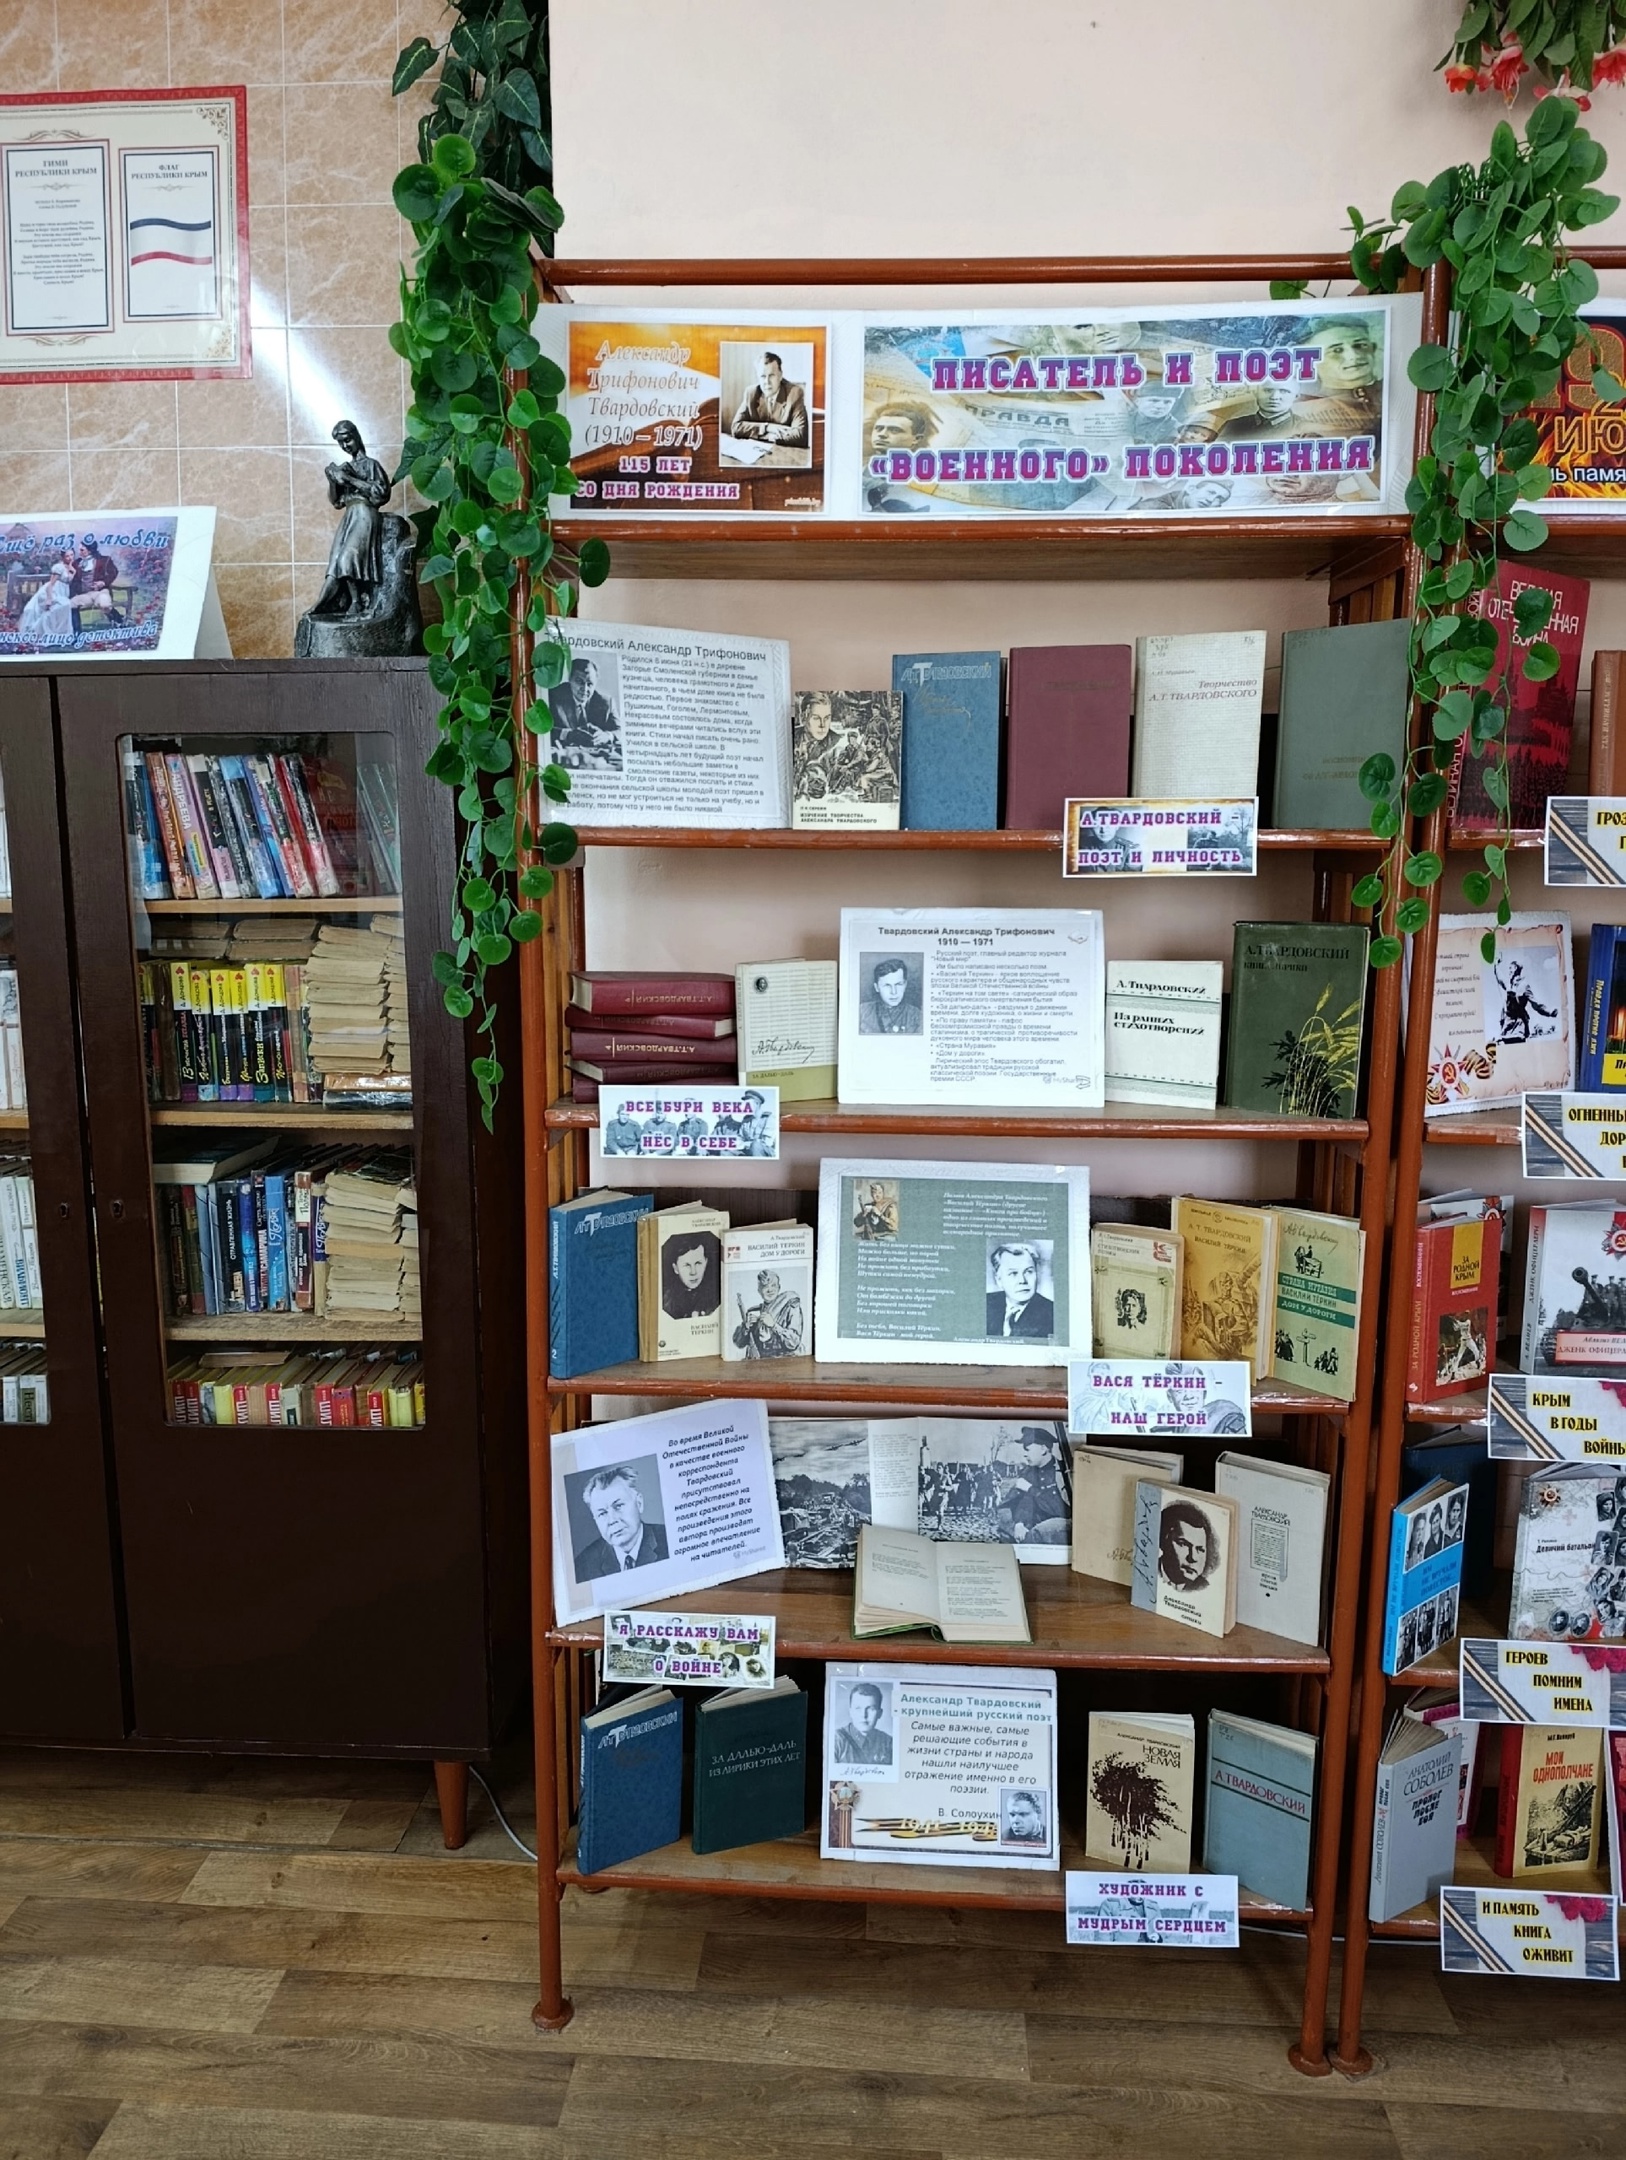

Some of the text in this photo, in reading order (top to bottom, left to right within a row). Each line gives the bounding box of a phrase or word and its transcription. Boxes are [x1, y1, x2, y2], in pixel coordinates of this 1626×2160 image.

[43, 159, 68, 167] ГИМН
[158, 163, 180, 172] ФЛАГ
[15, 167, 97, 178] РЕСПУБЛИКИ КРЫМ
[131, 171, 208, 180] РЕСПУБЛИКИ КРЫМ
[596, 341, 691, 365] Александр
[931, 344, 1324, 392] ПИСАТЕЛЬ И ПОЭТ
[588, 368, 699, 394] Трифонович
[589, 396, 700, 421] Твардовский
[619, 456, 692, 473] 115 ЛЕТ
[868, 436, 1376, 485] «ВОЕННОГО» ПОКОЛЕНИЯ
[602, 481, 640, 499] ДНЯ
[645, 482, 740, 500] РОЖДЕНИЯ
[39, 533, 75, 556] раз
[83, 532, 96, 546] о
[99, 529, 170, 549] любви
[38, 621, 158, 649] лицо детектива
[627, 640, 766, 662] Александр Трифонович
[1198, 679, 1258, 690] Творчество
[1170, 689, 1258, 700] ТВАРДОВСКОГО
[171, 773, 192, 829] АНДРЕЕВА
[1080, 808, 1222, 827] А.ТВАРДОВСКИЙ
[1078, 848, 1241, 866] ПОЭТ И ЛИЧНОСТЬ
[878, 926, 1055, 938] Твардовский Александр Трифонович
[937, 938, 994, 946] 1910 1971
[1114, 1012, 1175, 1025] Из ранних
[1114, 1021, 1205, 1036] стихотворений
[616, 1044, 695, 1053] А.Т.ТВАРДОВСКИЙ
[625, 1100, 753, 1114] ВСЕ БУРИ ВЕКА
[643, 1132, 737, 1149] НЁС В СЕБЕ
[1204, 1223, 1251, 1243] ТВАРДОВСКИЙ
[228, 1222, 237, 1260] ОТРАВЛЕННАЯ
[748, 1241, 806, 1251] ВАСИЛИЙ ТЕРКИН
[1453, 1260, 1480, 1273] РОДНОЙ
[1462, 1256, 1470, 1264] ЗА
[1455, 1271, 1475, 1281] КРЫМ
[1281, 1301, 1337, 1320] ДОМ ДОРОГИ
[1557, 1346, 1586, 1354] ДЖЕНК
[1093, 1373, 1206, 1389] ВАСЯ ТЁРКИН
[1533, 1393, 1571, 1408] КРЫМ
[1111, 1409, 1207, 1425] НАШ ГЕРОЙ
[1550, 1417, 1598, 1430] В ГОДЫ
[669, 1425, 734, 1447] Во время Великой
[663, 1434, 749, 1459] Отечественной Войны
[678, 1458, 738, 1478] корреспондента
[687, 1468, 733, 1486] Твардовский
[678, 1508, 753, 1532] произведения этого
[1536, 1544, 1565, 1553] Девичий
[619, 1624, 759, 1639] Я РАССКАЖУ ВАМ
[1505, 1651, 1549, 1665] ГЕРОЕВ
[654, 1658, 721, 1674] О ВОЙНЕ
[1533, 1674, 1582, 1689] ПОМНИМ
[901, 1694, 1042, 1709] Александр Твардовский
[1553, 1697, 1593, 1711] ИМЕНА
[901, 1707, 1052, 1722] крупнейший русский поэт
[911, 1721, 1030, 1736] Самые важные, самые
[913, 1734, 1019, 1747] решающие события
[712, 1739, 797, 1764] ЗА ДАЛЬЮ-ДАЛЬ
[1143, 1745, 1181, 1760] НОВАЯ
[1545, 1751, 1564, 1766] МОИ
[708, 1752, 801, 1777] ИЗ ЛИРИКИ ЭТИХ ЛЕТ
[1144, 1756, 1181, 1769] ЗЕМЛЯ
[1407, 1751, 1452, 1779] АНАТОЛИЙ
[904, 1771, 1037, 1786] отражение именно его
[1404, 1764, 1453, 1796] СОБОЛЕВ
[1533, 1763, 1594, 1783] ОДНОПОЛЧАНЕ
[1215, 1769, 1305, 1815] А.ТВАРДОВСКИЙ
[1412, 1790, 1443, 1810] ПРОЛОГ
[938, 1807, 1002, 1820] В. Солоухин
[1413, 1802, 1441, 1819] ПОСЛЕ
[1418, 1813, 1434, 1827] БОЯ
[1099, 1883, 1204, 1897] ХУДОЖНИК С
[1482, 1901, 1540, 1917] И ПАМЯТЬ
[1078, 1918, 1227, 1934] МУДРЫМ СЕРДЦЕМ
[1513, 1925, 1552, 1939] КНИГА
[1522, 1947, 1574, 1963] ОЖИВИТ
